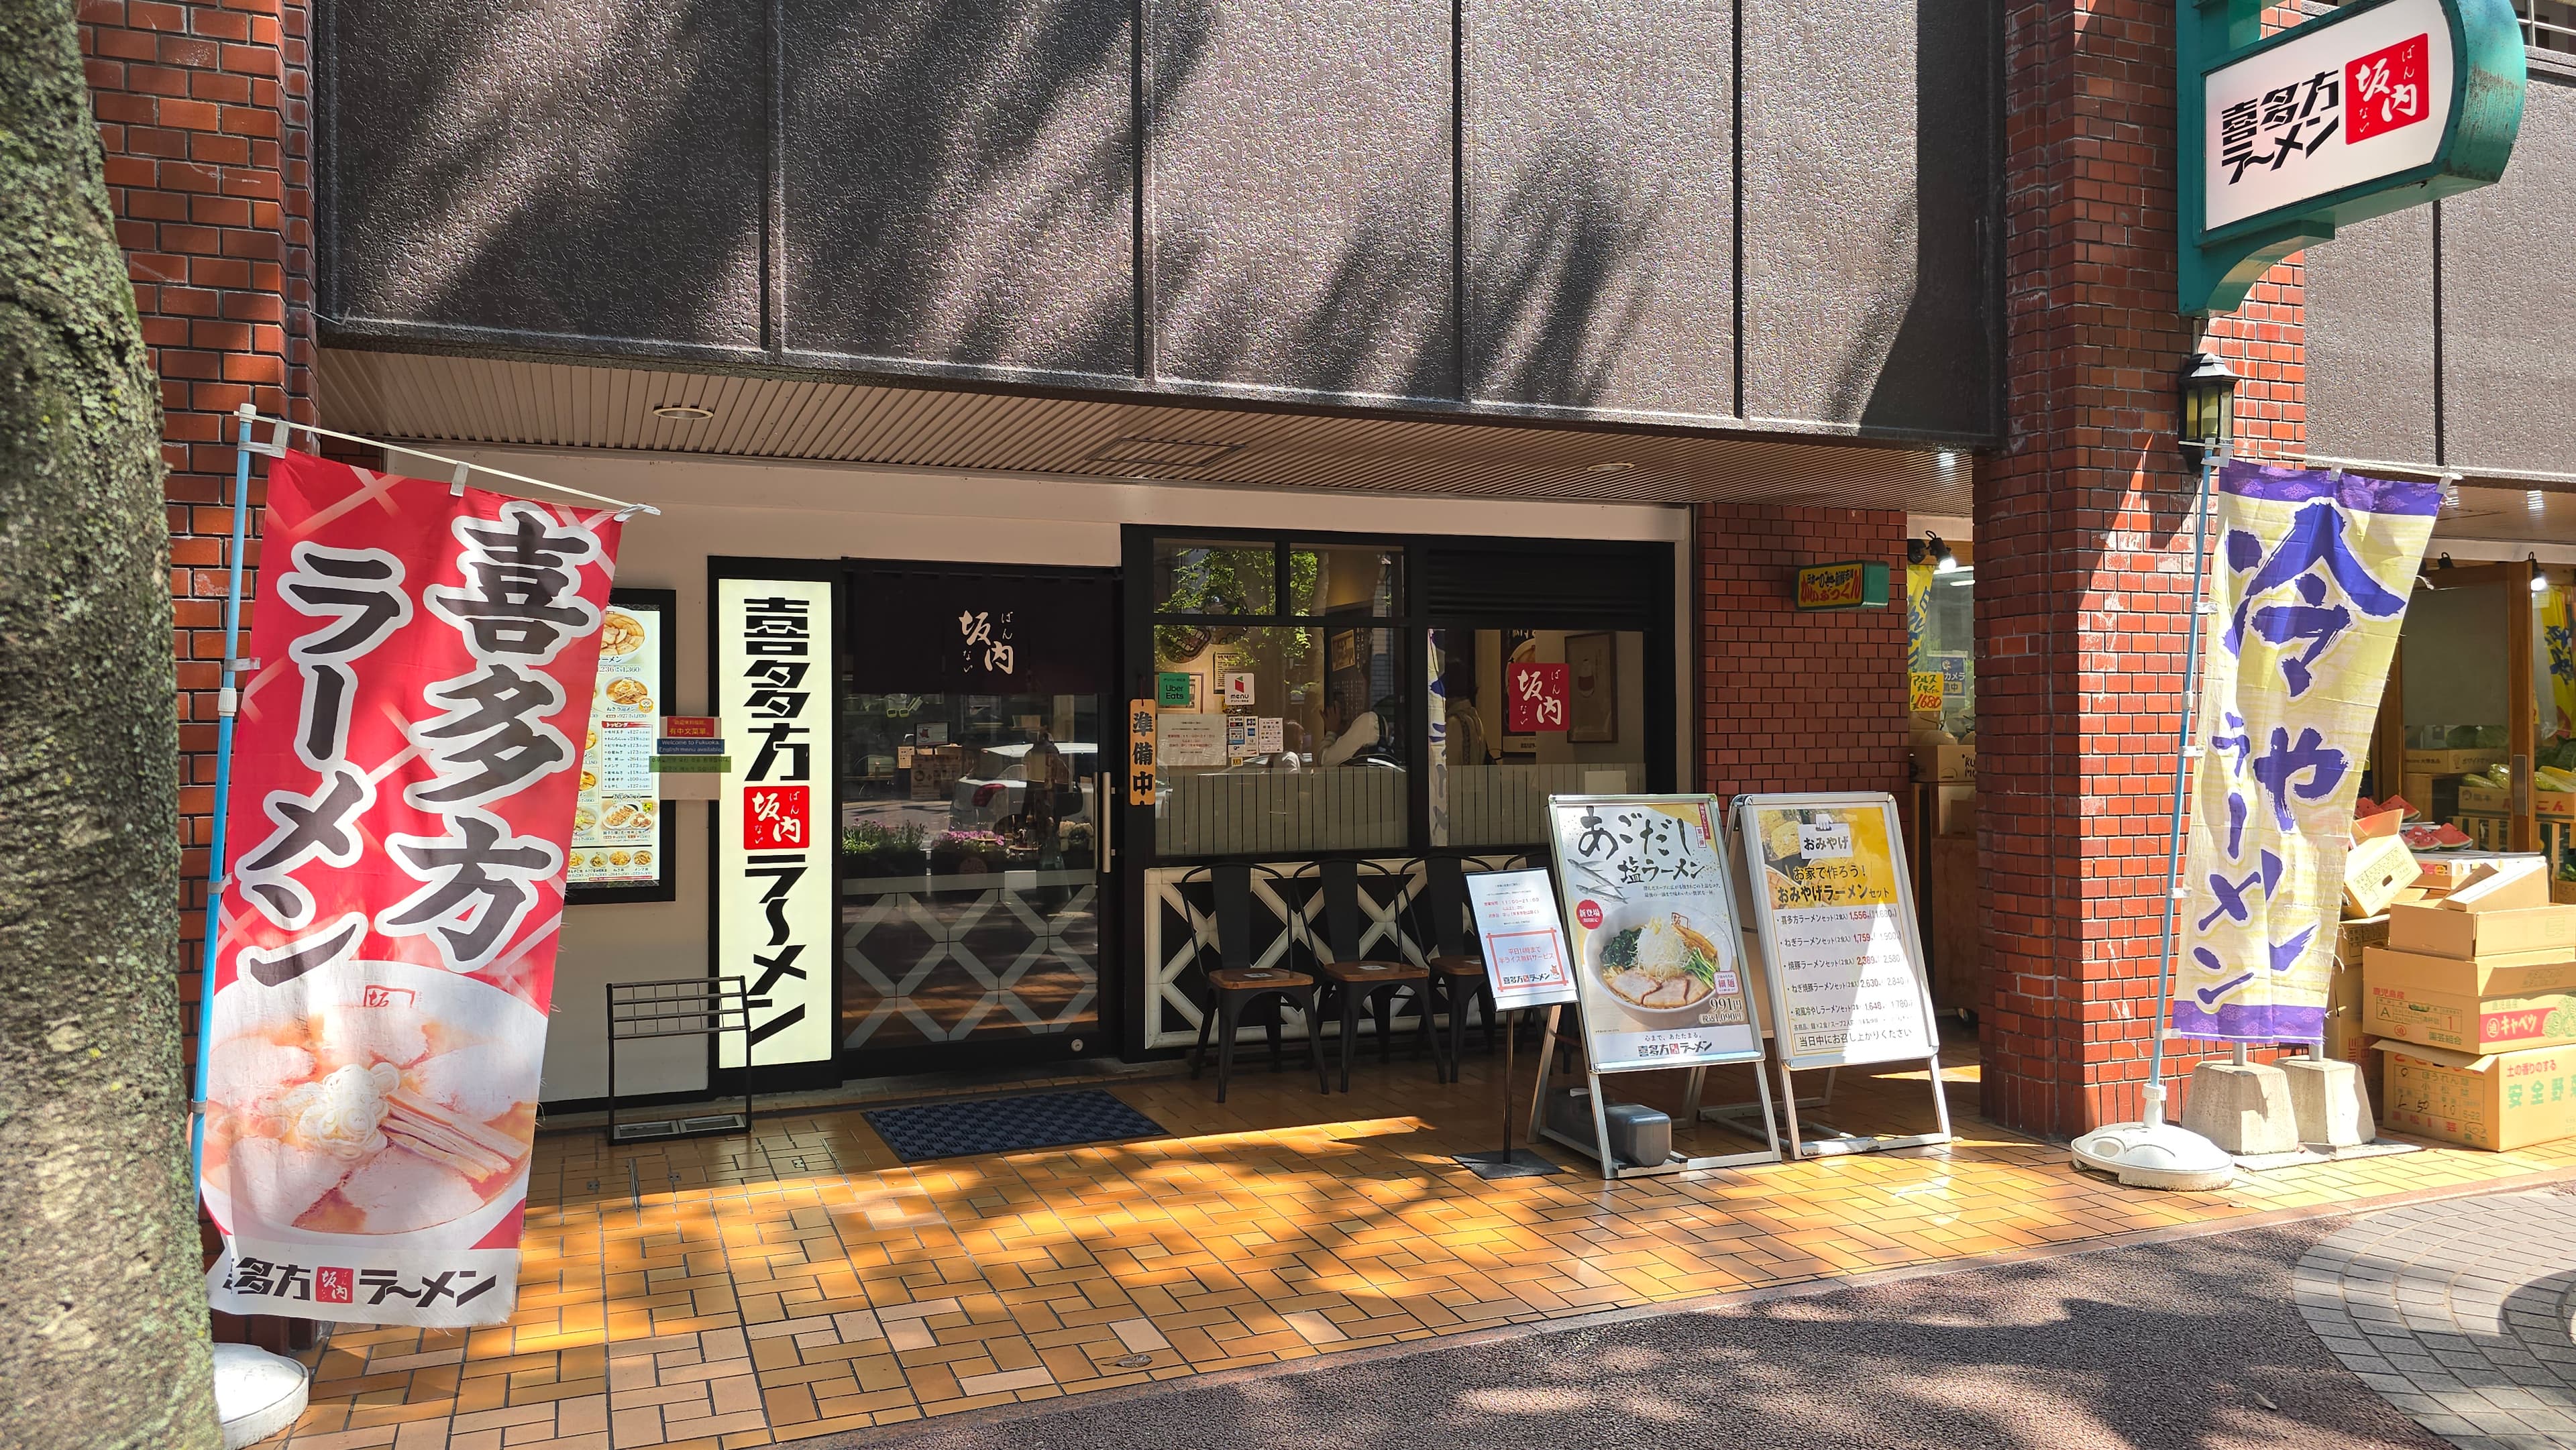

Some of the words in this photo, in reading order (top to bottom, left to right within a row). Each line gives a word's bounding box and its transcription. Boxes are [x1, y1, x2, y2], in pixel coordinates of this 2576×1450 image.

[2355, 58, 2417, 123] 坂内
[2222, 69, 2339, 158] 喜多方
[2222, 114, 2339, 185] ラーメン
[1002, 611, 1014, 639] ばん
[959, 610, 1014, 675] 坂内
[743, 597, 810, 781] 喜多方
[1551, 669, 1561, 694] ばん
[1517, 669, 1562, 725] 坂内
[1917, 694, 1942, 709] 1680
[385, 510, 590, 961] 喜多方
[1132, 711, 1154, 796] 準備中
[245, 552, 401, 987] ラーメン
[789, 791, 800, 814] ばん
[751, 791, 801, 843] 坂内
[1578, 805, 1691, 860] あごだし
[1803, 836, 1848, 850] おみやげ
[1617, 856, 1705, 884] 塩ラーメン
[1778, 883, 1890, 903] おみやげラーメンセット
[745, 854, 809, 1046] ラーメン
[1503, 975, 1523, 985] 喜多方
[1529, 972, 1550, 982] ラーメン
[1710, 997, 1742, 1012] 991円
[2373, 987, 2405, 999] 鹿児島産
[2381, 1007, 2390, 1017] A
[2501, 1014, 2537, 1036] キャベツ
[1638, 1044, 1670, 1057] 喜多方
[1679, 1040, 1713, 1054] ラーメン
[1644, 1032, 1702, 1042] 心まで、あたたまる。
[2507, 1059, 2557, 1078] 土の香りのする
[359, 1270, 497, 1308] ラーメン
